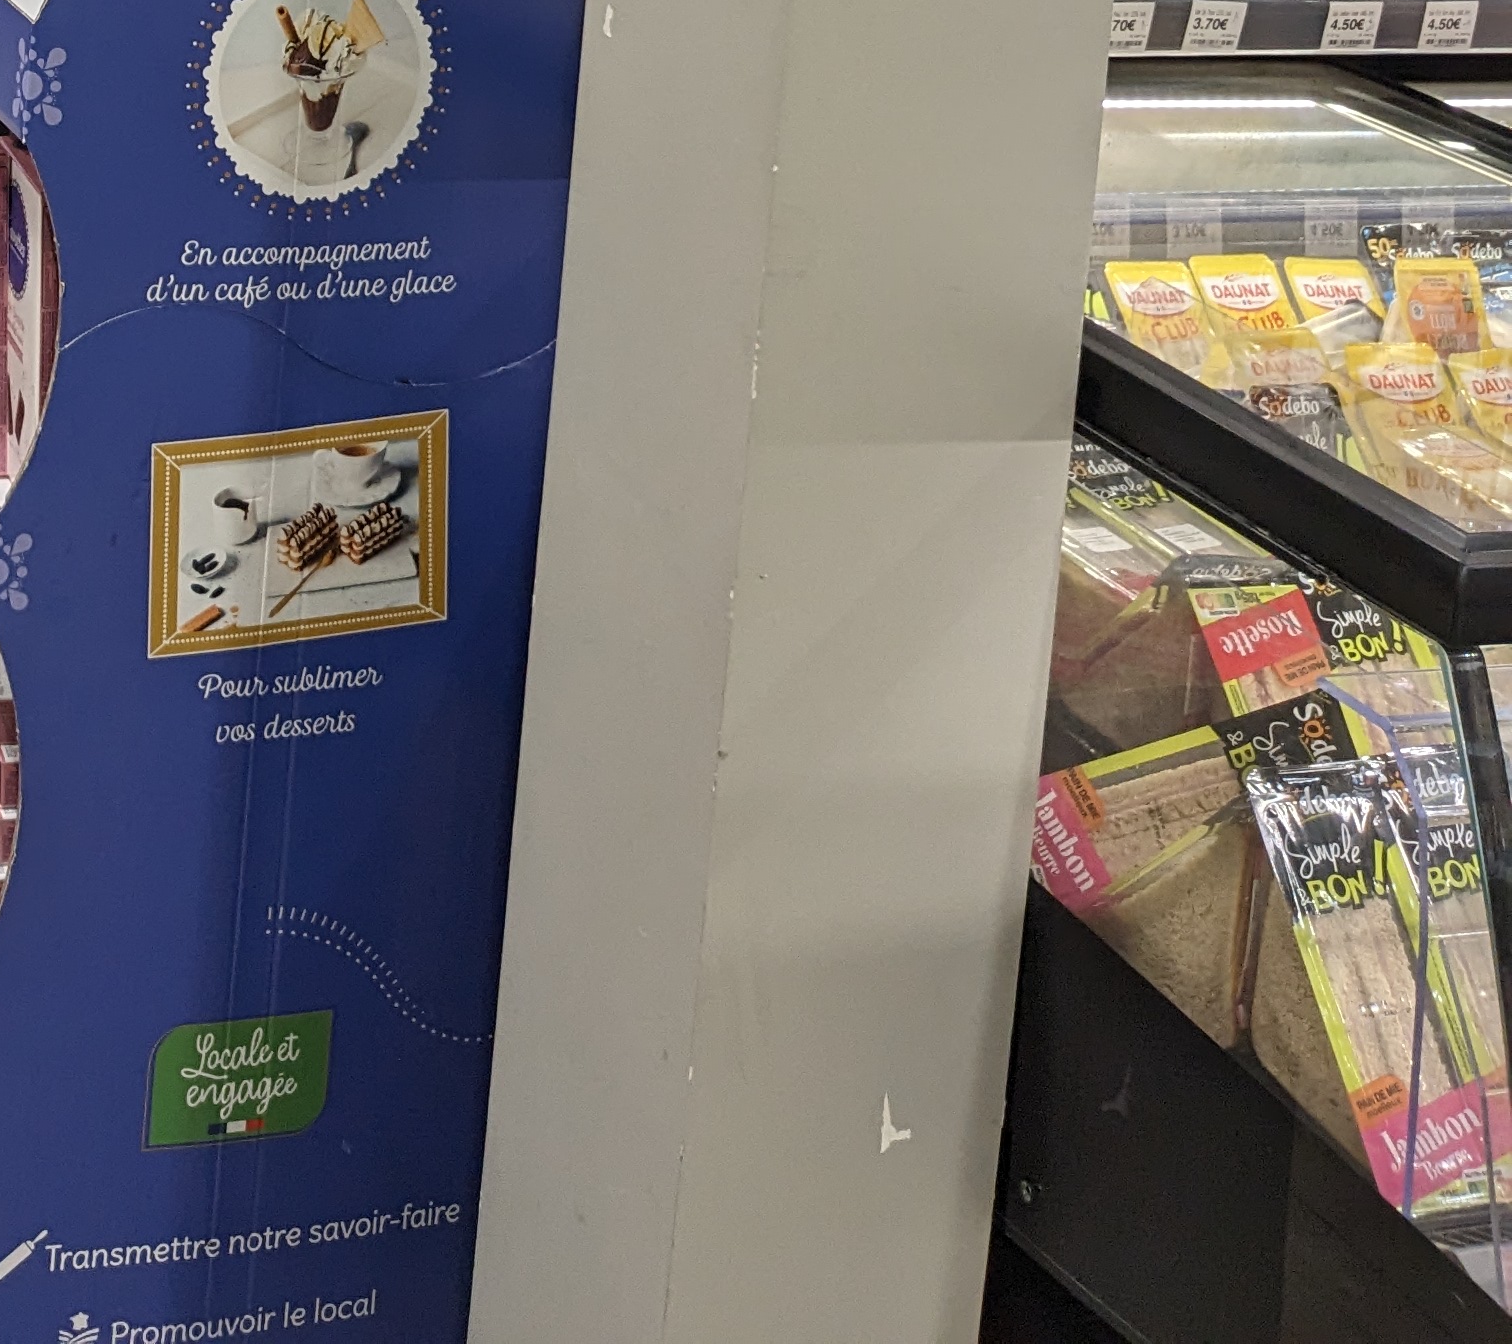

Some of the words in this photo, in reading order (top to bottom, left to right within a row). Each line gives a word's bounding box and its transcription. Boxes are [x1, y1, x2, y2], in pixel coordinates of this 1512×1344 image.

[1112, 19, 1136, 32] 70€
[1193, 17, 1229, 30] 3.70€
[1330, 19, 1365, 31] 4.50€
[1428, 18, 1461, 30] 4.50€
[181, 240, 218, 266] En
[222, 236, 432, 271] accompagnement
[146, 275, 209, 303] d'un
[214, 276, 271, 308] café
[276, 282, 311, 300] ou
[316, 271, 387, 299] d'une
[390, 270, 456, 303] glace
[1128, 290, 1186, 304] DAUNAT
[1211, 283, 1271, 298] DAUNAT
[1303, 284, 1364, 299] DAUNAT
[1151, 317, 1199, 341] CLUB
[1368, 372, 1436, 390] DAUNAT
[1219, 610, 1304, 656] Rosette
[1317, 600, 1381, 639] Simple
[1338, 631, 1391, 662] BON
[198, 673, 269, 699] Pour
[272, 665, 382, 694] sublimer
[216, 722, 256, 743] vos
[264, 710, 355, 739] desserts
[1285, 823, 1362, 879] Simple
[1306, 870, 1367, 911] BON
[1427, 854, 1481, 899] BON
[181, 1027, 274, 1080] Locale
[277, 1033, 300, 1061] et
[187, 1072, 298, 1120] engagée
[1380, 1108, 1482, 1173] Jambon
[45, 1236, 220, 1273] Transmettre
[227, 1225, 301, 1255] notre
[308, 1201, 460, 1245] savoir-faire
[110, 1306, 277, 1344] Promouvoir
[283, 1301, 307, 1327] le
[314, 1289, 378, 1324] local
